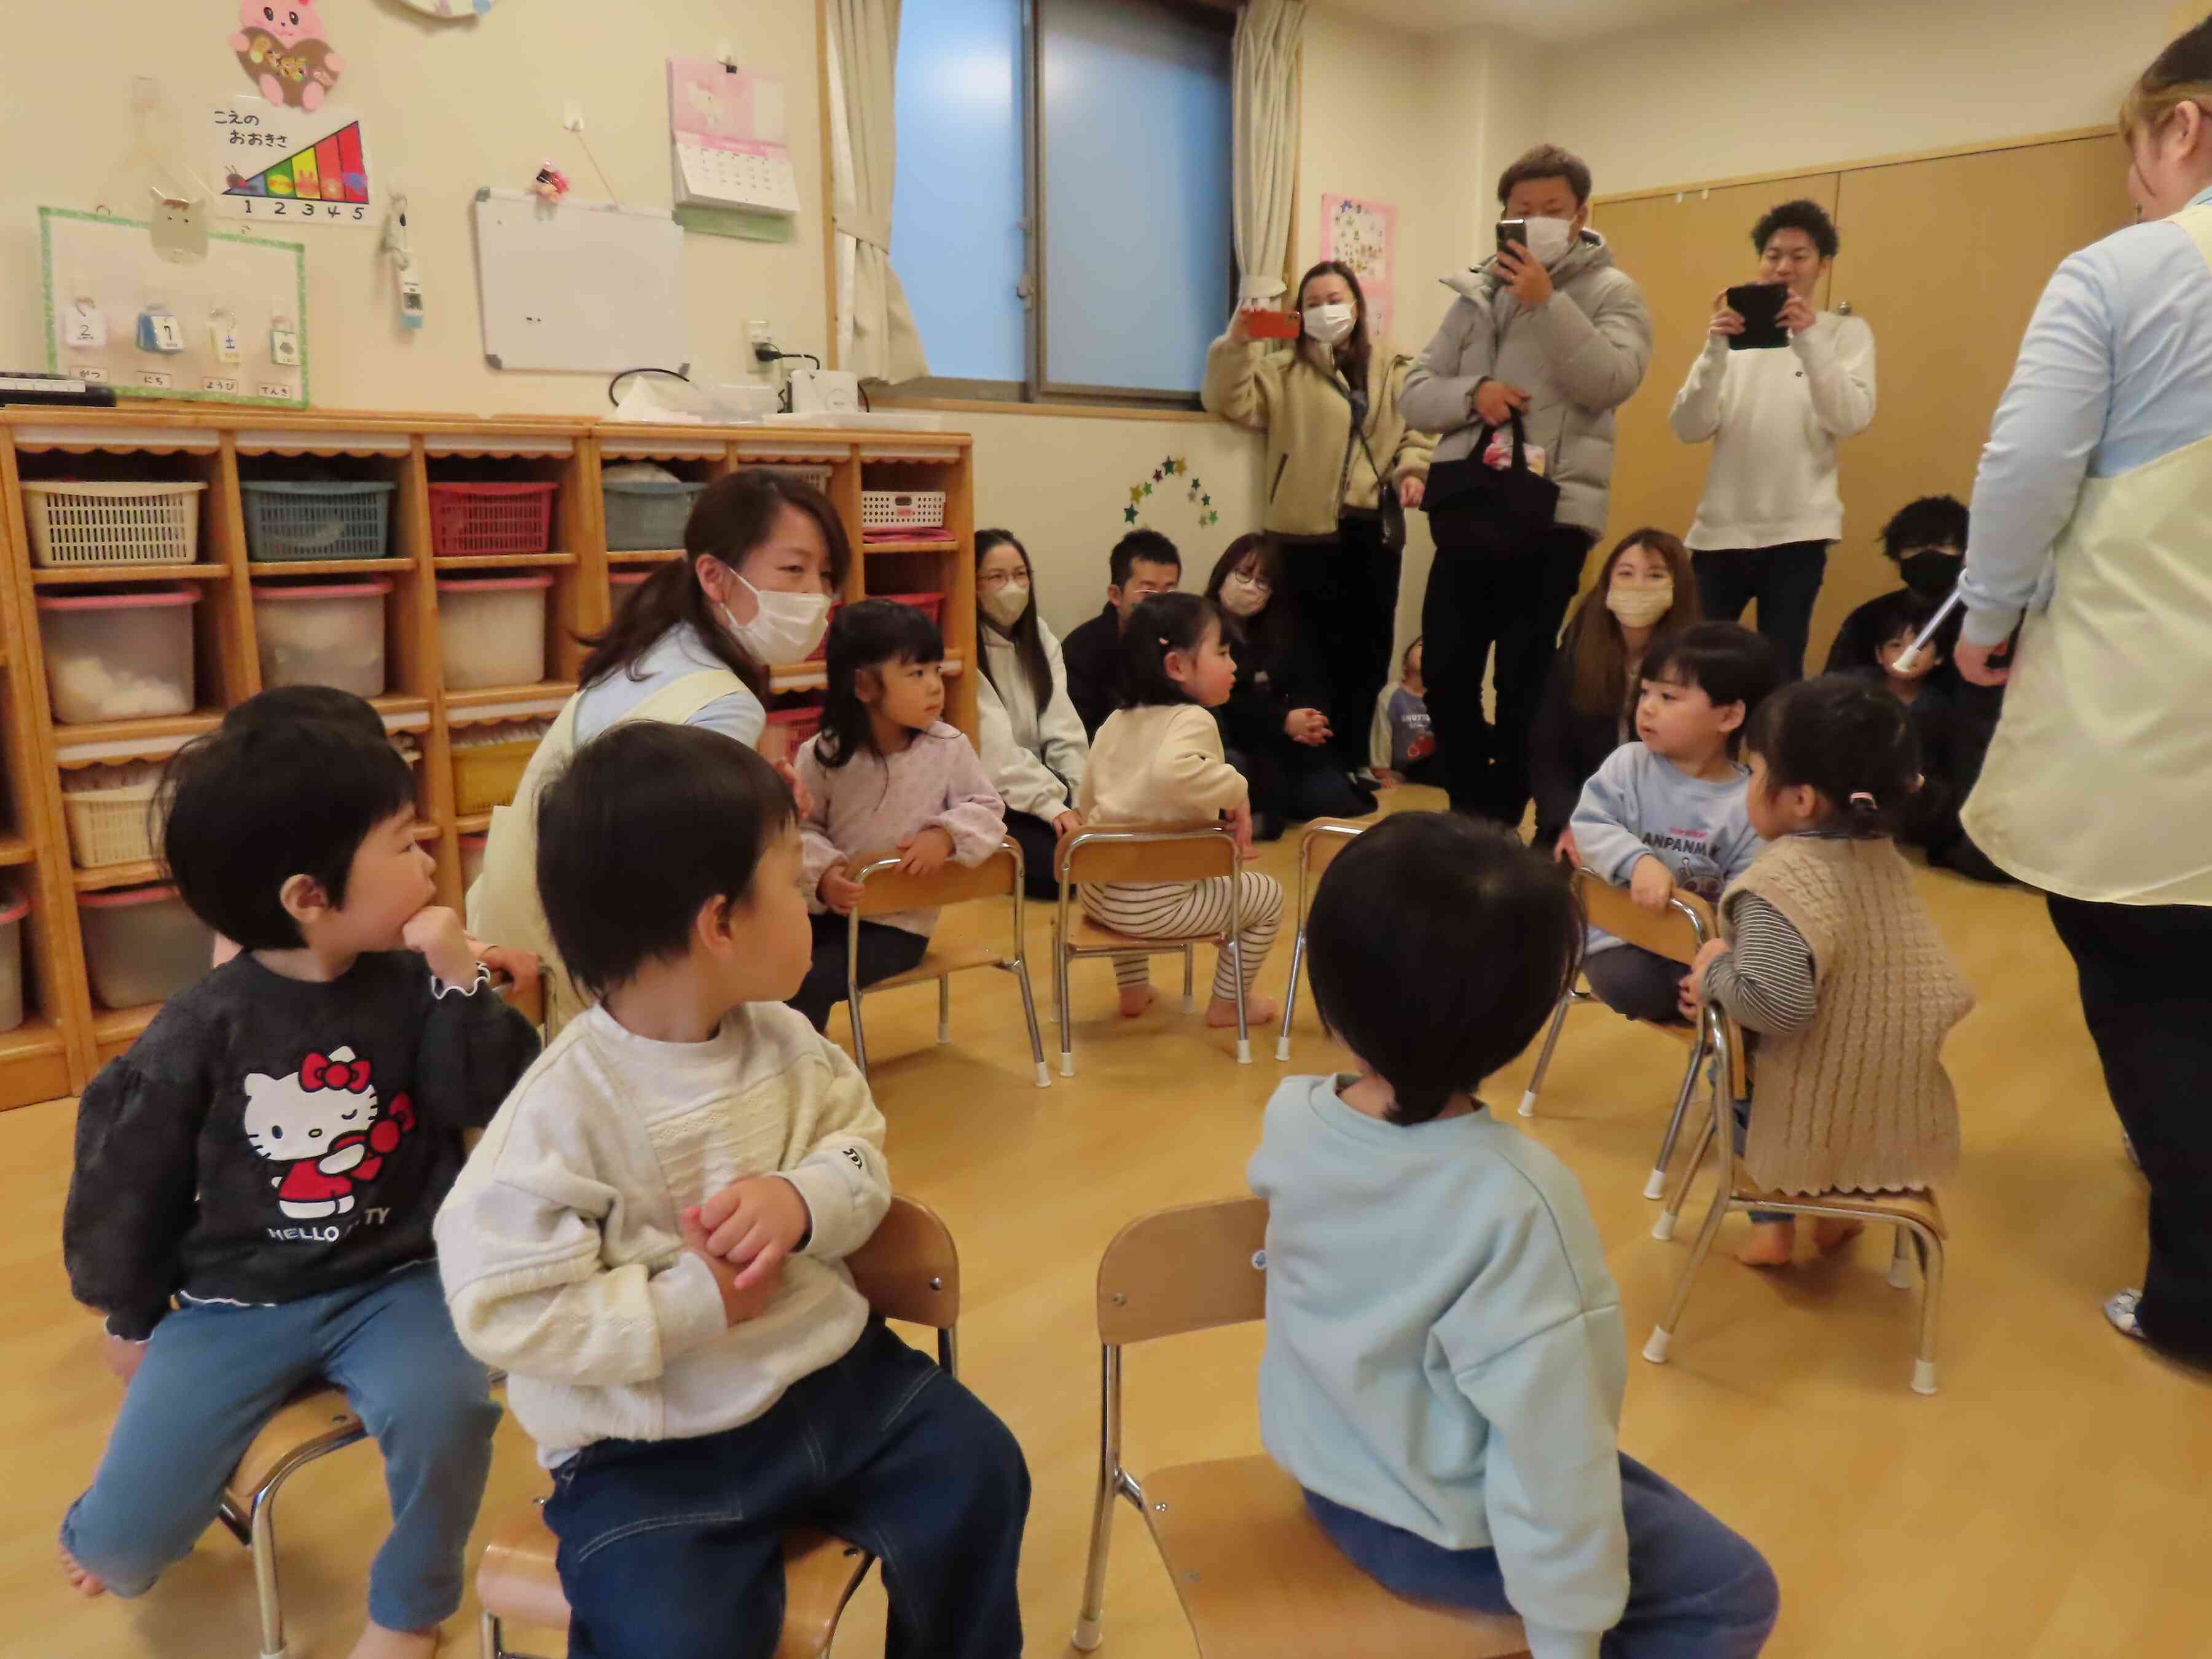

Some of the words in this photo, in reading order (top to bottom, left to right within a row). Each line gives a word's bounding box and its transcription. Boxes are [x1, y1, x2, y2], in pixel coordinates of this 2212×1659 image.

[214, 111, 259, 126] こえの
[229, 130, 288, 148] おおきさ
[244, 200, 253, 214] 1
[274, 202, 287, 215] 2
[302, 203, 315, 216] 3
[327, 205, 341, 218] 4
[353, 207, 364, 220] 5
[80, 324, 91, 336] 2
[226, 335, 236, 349] 土
[144, 375, 163, 385] にち
[1641, 831, 1721, 858] ANPANM
[267, 1226, 340, 1242] HELLO
